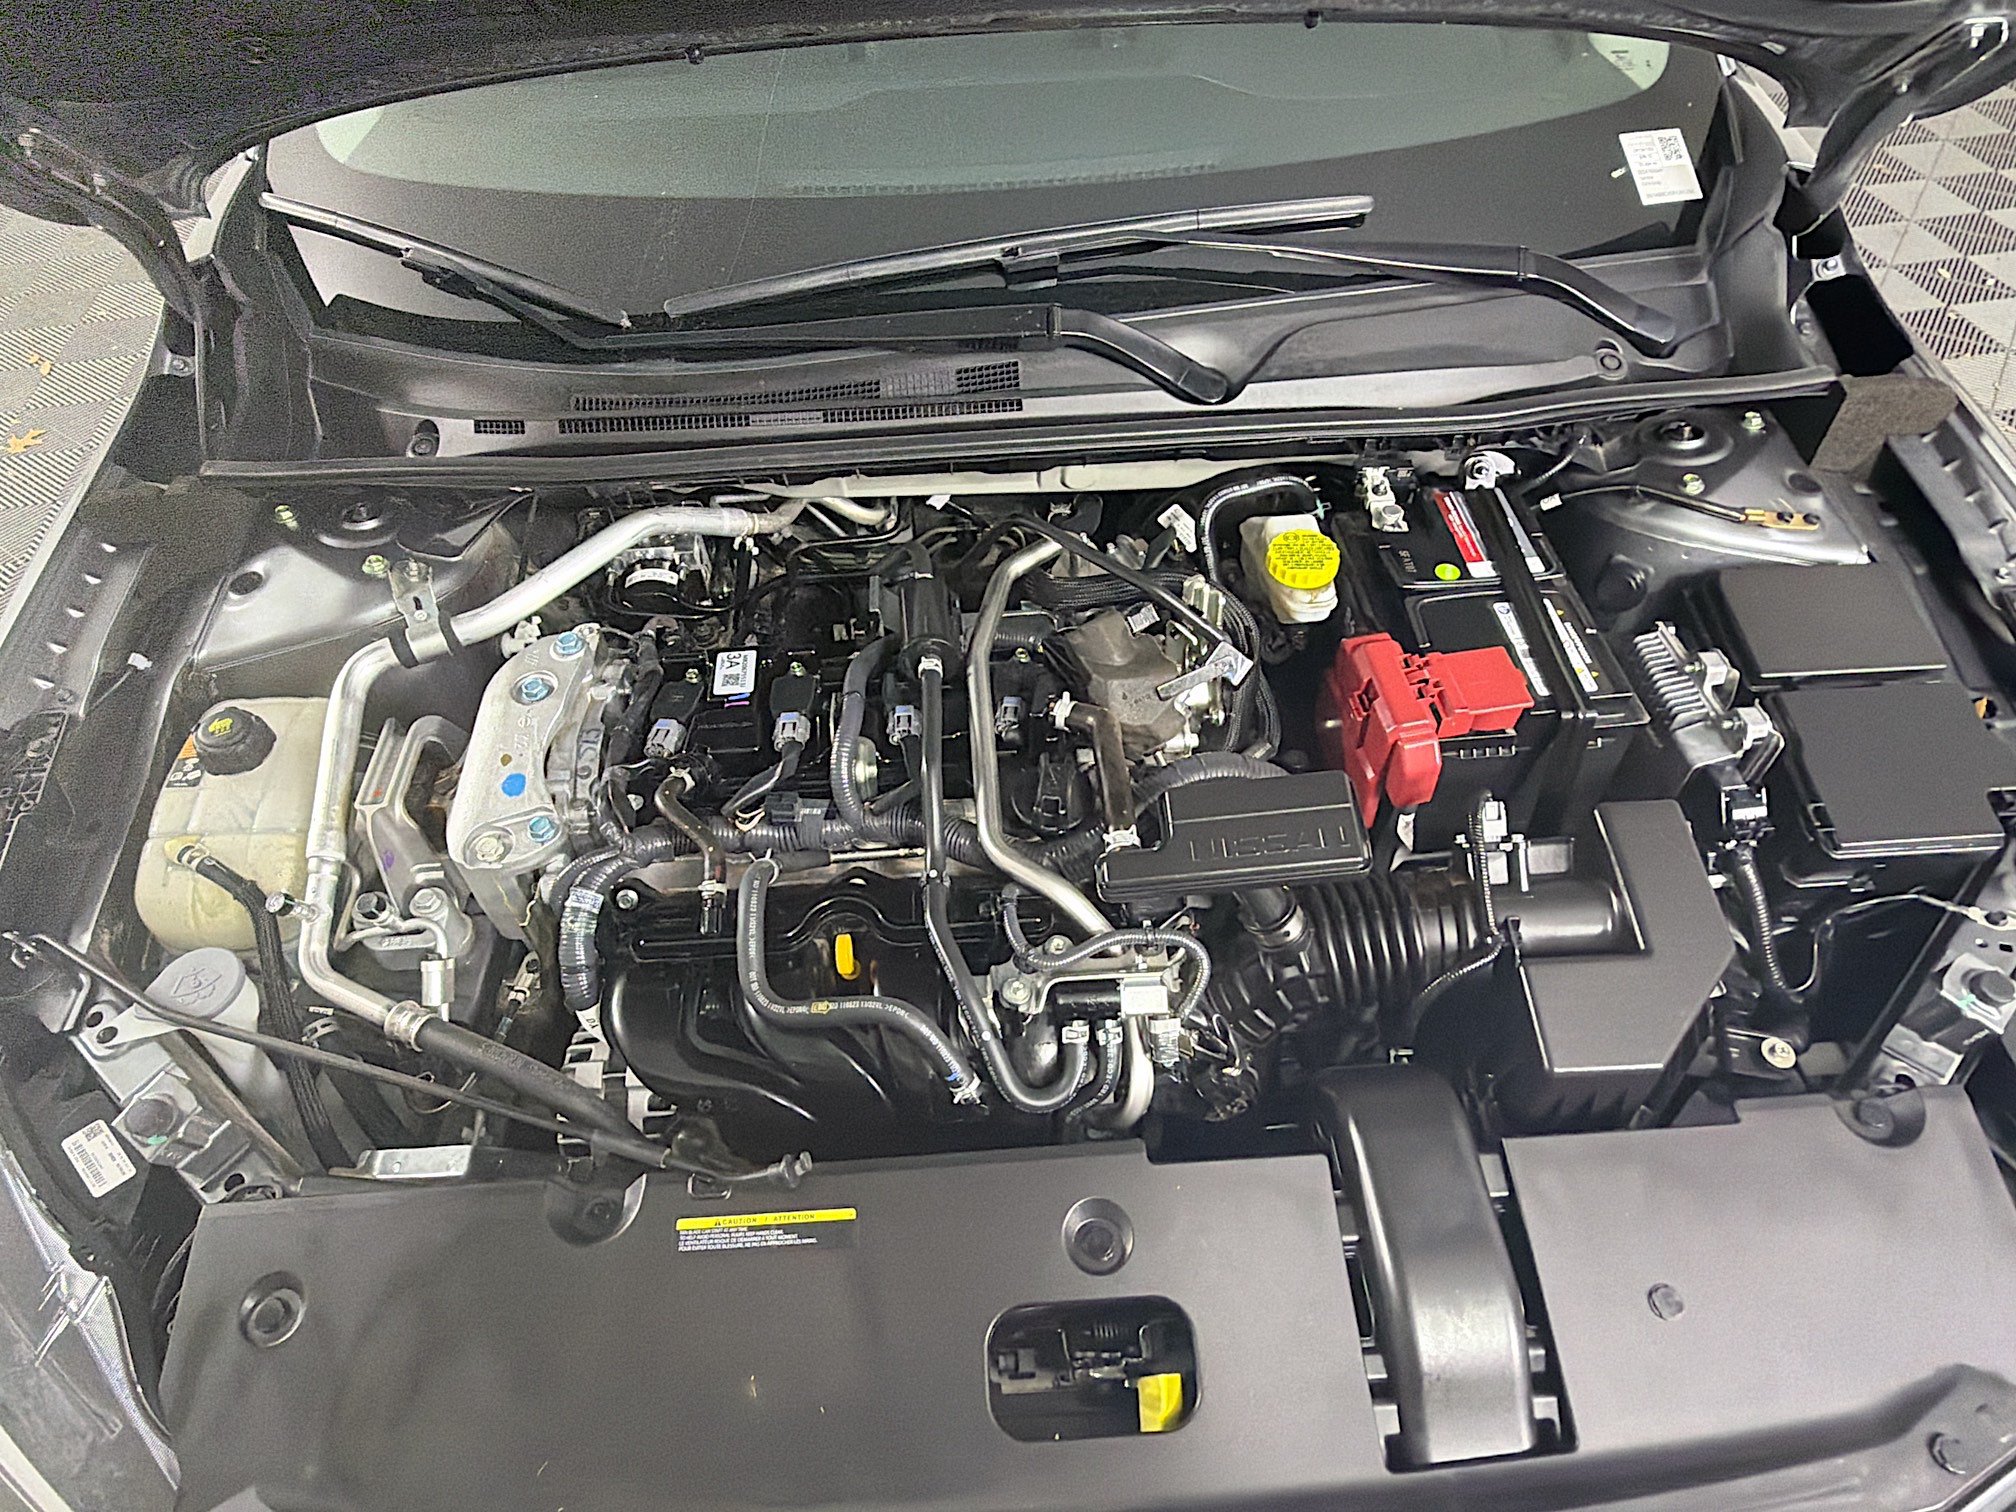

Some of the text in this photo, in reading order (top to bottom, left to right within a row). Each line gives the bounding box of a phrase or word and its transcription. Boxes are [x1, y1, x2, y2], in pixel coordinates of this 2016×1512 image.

[725, 653, 742, 670] 3A
[1189, 825, 1352, 862] NISSAN
[722, 1217, 757, 1225] CAUTION
[773, 1213, 815, 1222] ATTENTION
